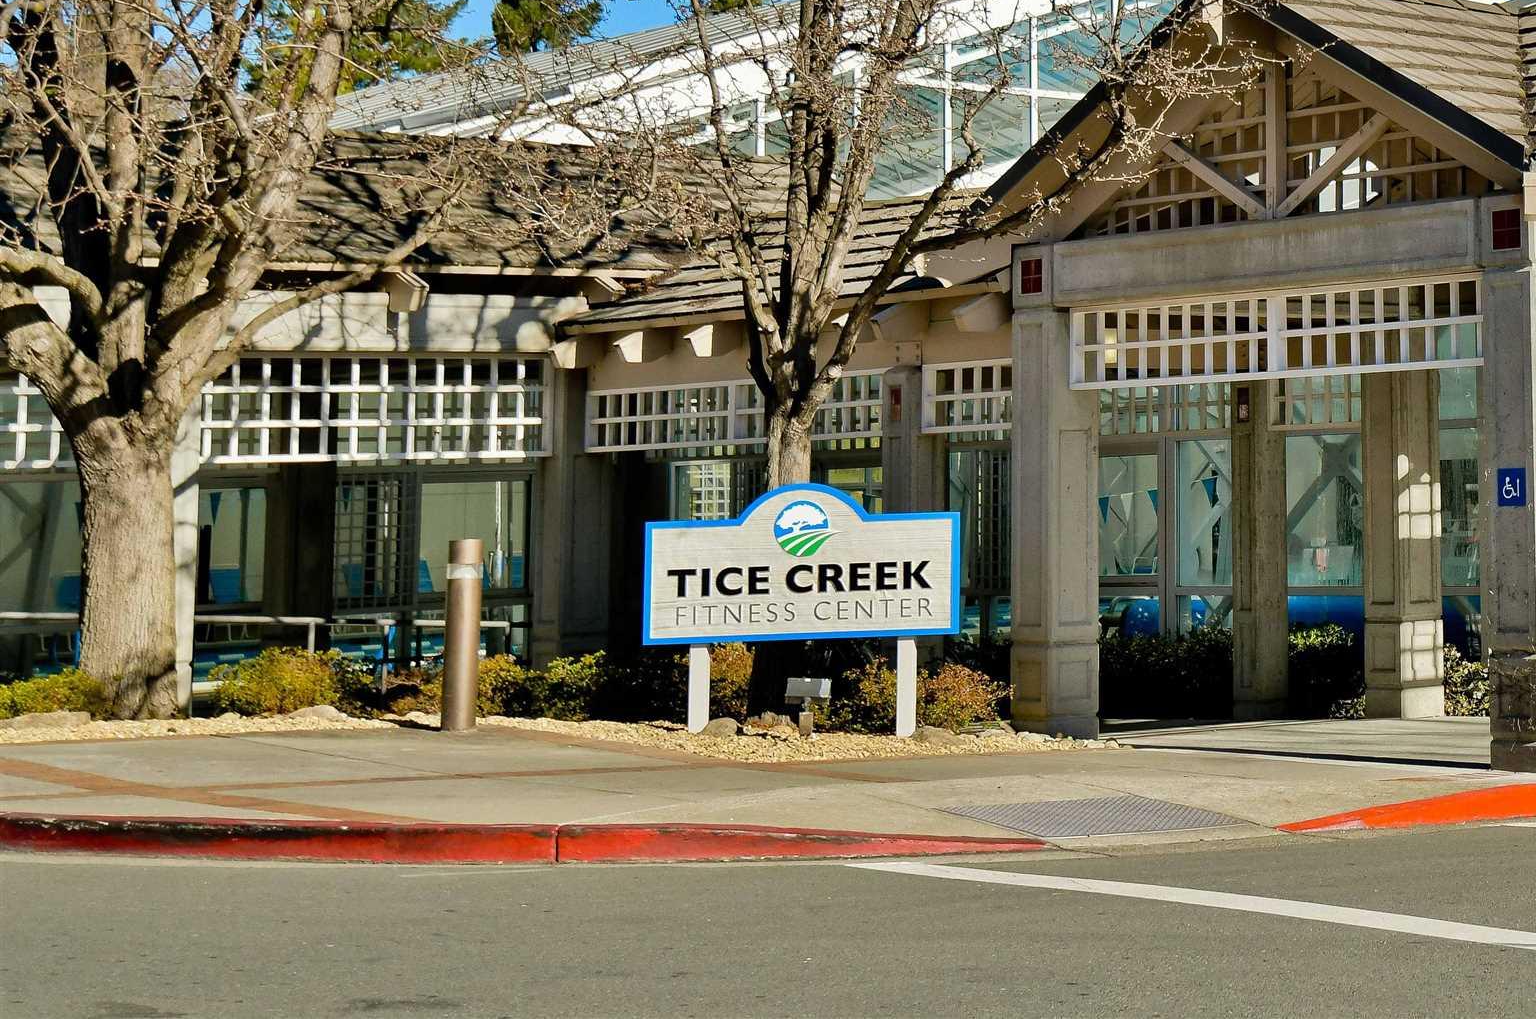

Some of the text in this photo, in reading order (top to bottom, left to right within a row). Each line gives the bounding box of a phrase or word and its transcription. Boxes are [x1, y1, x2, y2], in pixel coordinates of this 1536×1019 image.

[667, 560, 933, 598] TICE CREEK
[676, 598, 933, 626] FITNESS CENTER
